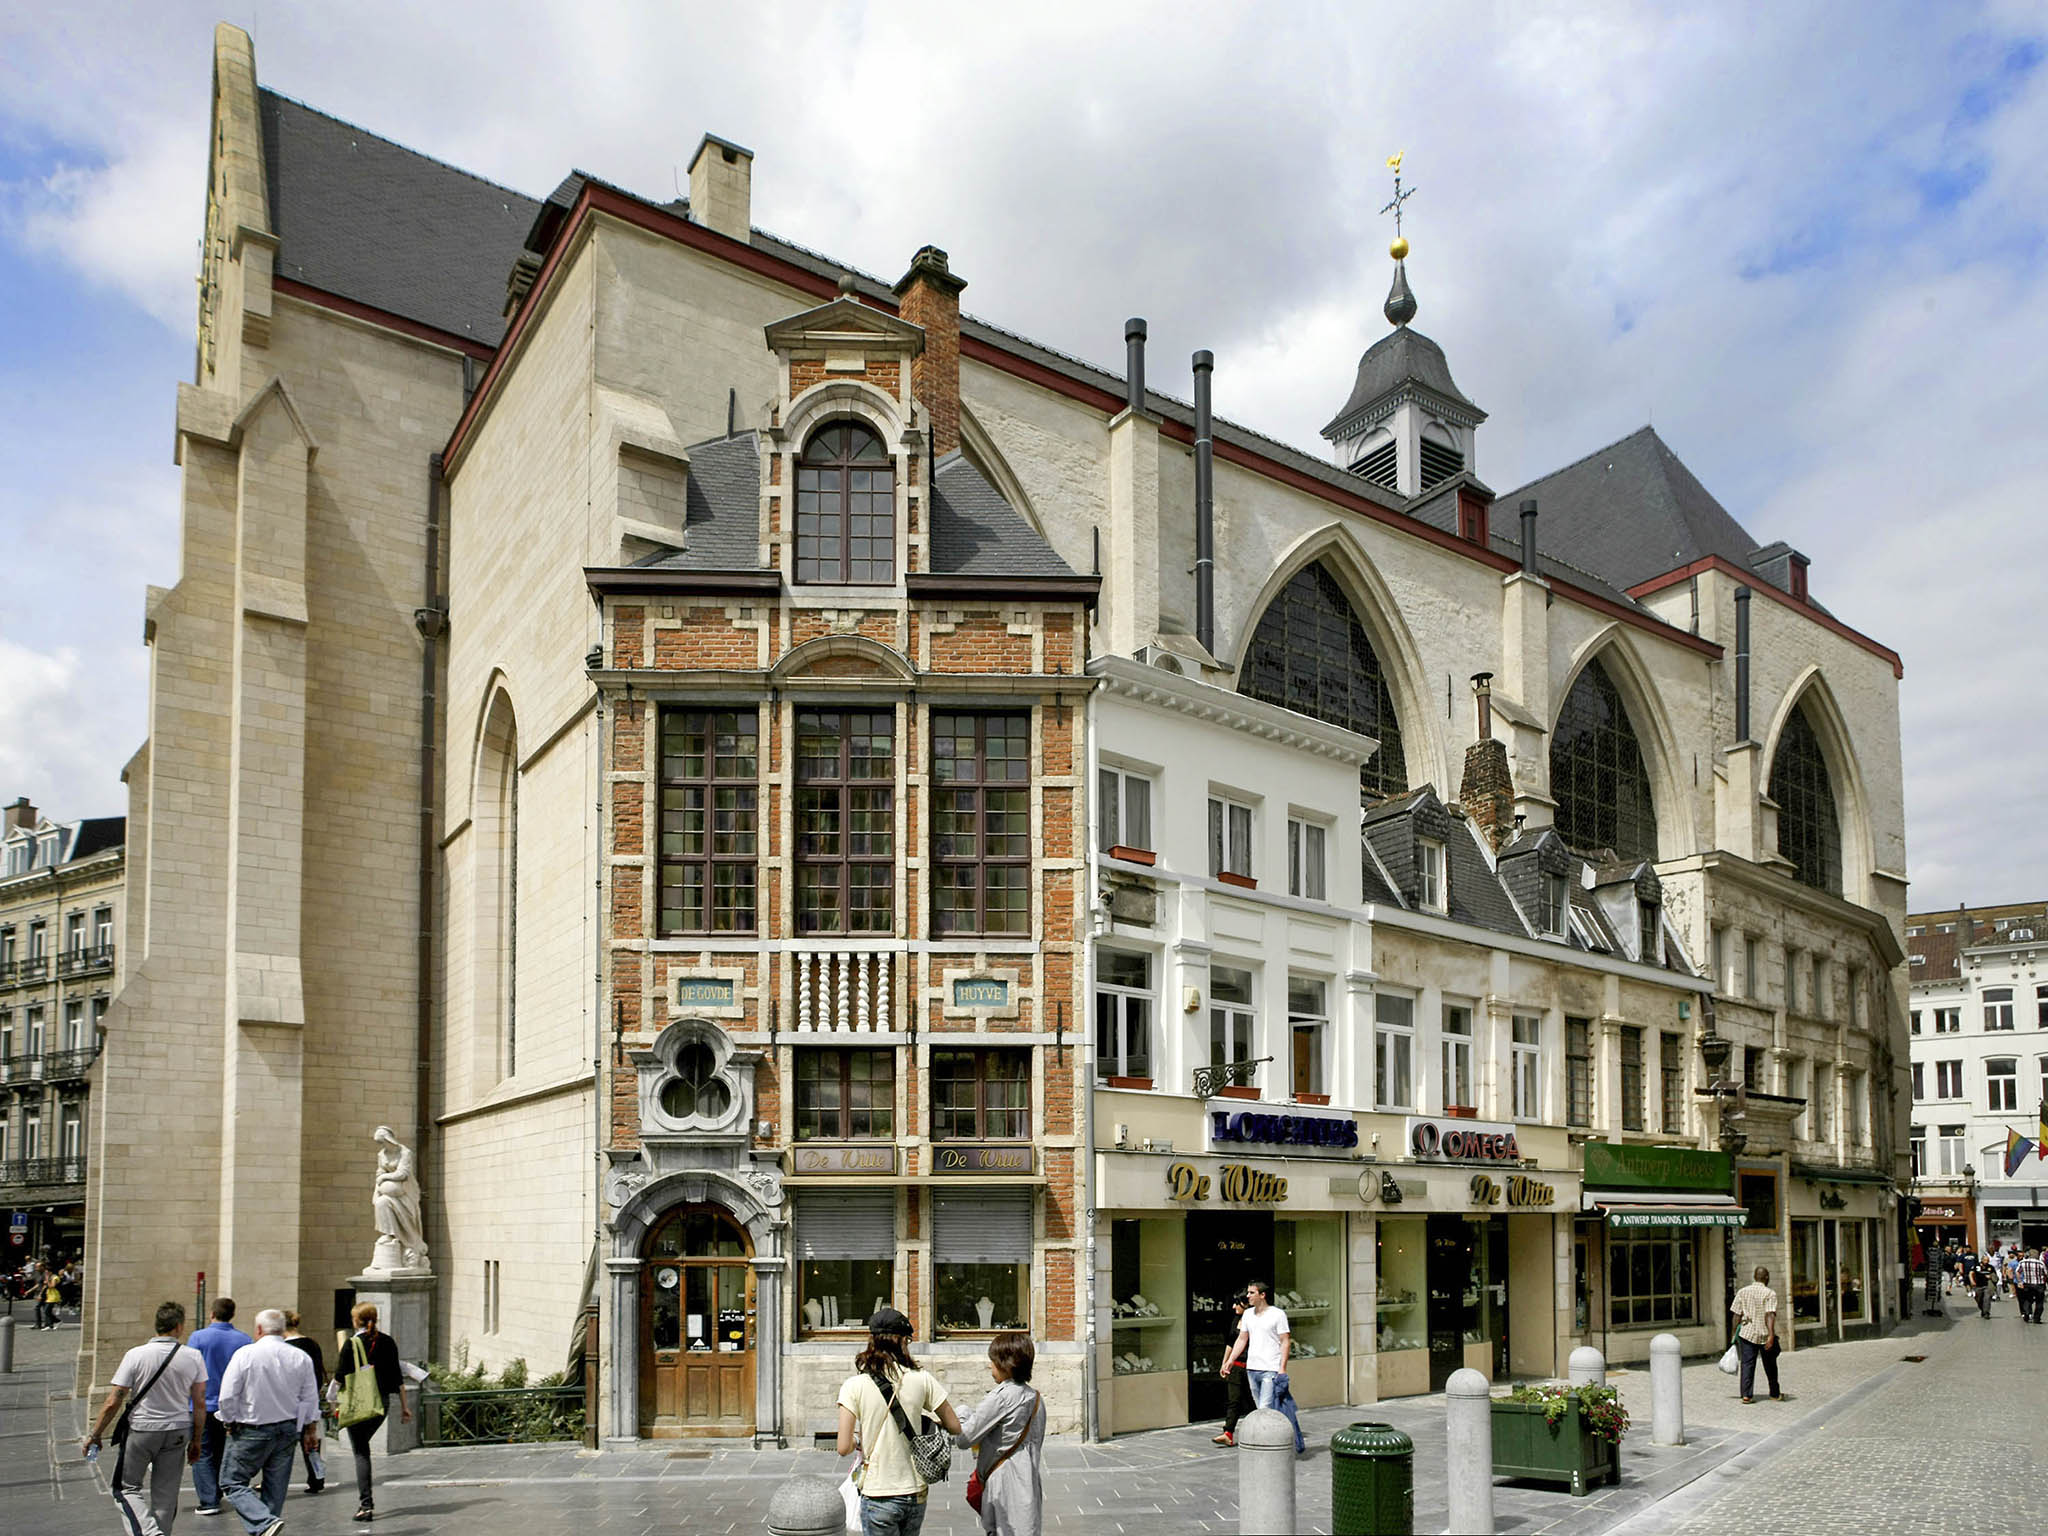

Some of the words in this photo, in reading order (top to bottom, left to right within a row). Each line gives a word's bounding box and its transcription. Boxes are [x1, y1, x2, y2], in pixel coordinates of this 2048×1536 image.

[680, 985, 696, 1001] DE
[960, 986, 1002, 1001] HUYVE
[1442, 1130, 1520, 1160] OMEGA
[803, 1150, 830, 1169] De
[941, 1149, 968, 1169] De
[1616, 1151, 1671, 1183] Antwerp
[1676, 1154, 1714, 1178] Jewels
[1167, 1162, 1211, 1201] De
[1219, 1164, 1289, 1203] Witte
[1470, 1174, 1502, 1205] De
[1506, 1175, 1555, 1206] Witte
[1622, 1215, 1650, 1225] ANTWERP
[1651, 1215, 1681, 1225] DIAMONDS
[1715, 1216, 1726, 1225] TAX
[1726, 1216, 1738, 1225] FREE
